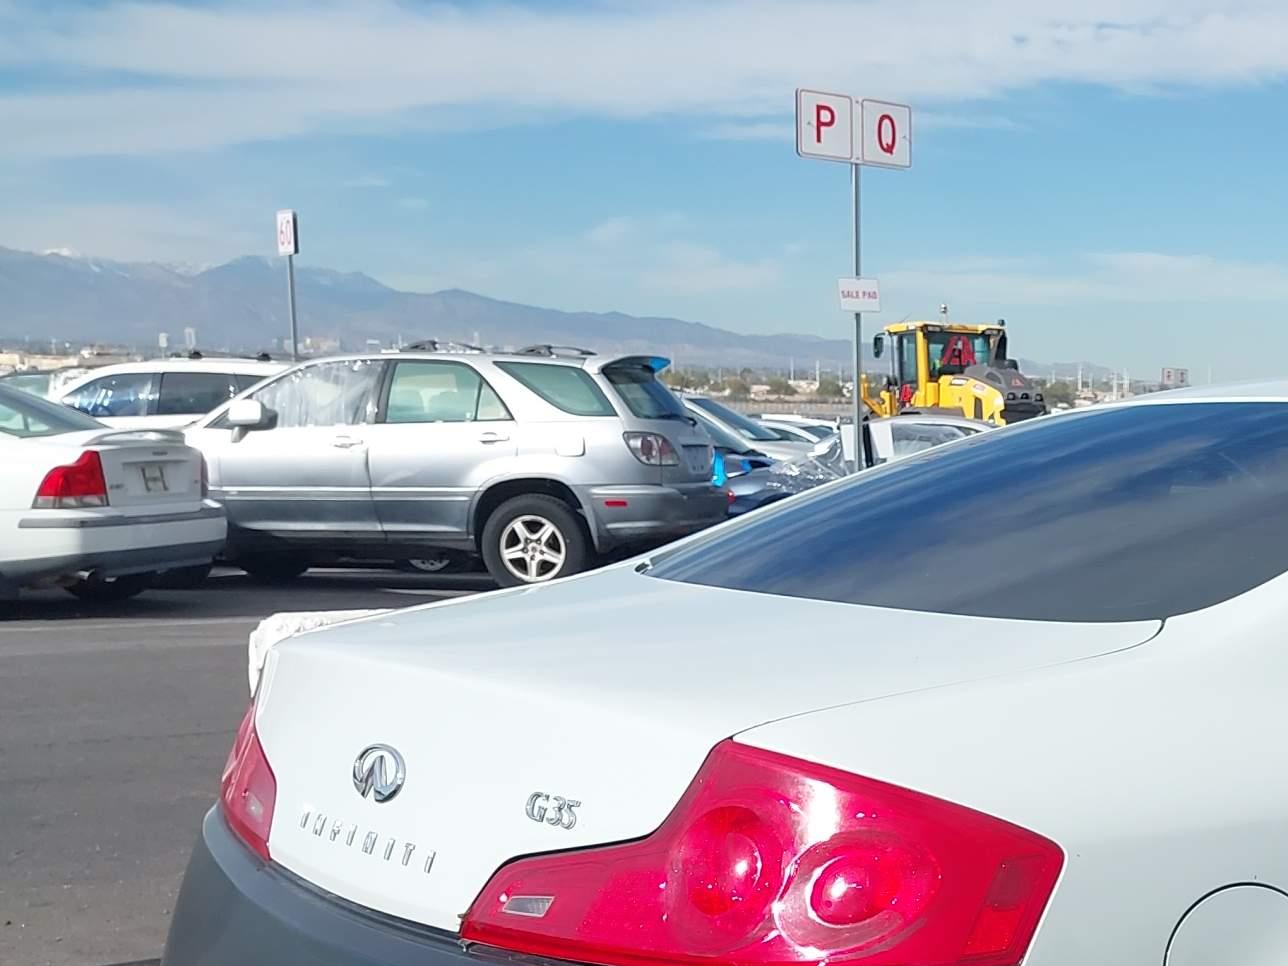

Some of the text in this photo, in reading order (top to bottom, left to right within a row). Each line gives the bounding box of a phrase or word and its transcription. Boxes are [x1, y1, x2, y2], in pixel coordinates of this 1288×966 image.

[816, 104, 835, 143] P
[877, 114, 897, 155] Q
[279, 216, 292, 246] 60
[841, 290, 878, 300] SALE PAD
[525, 791, 582, 830] G35
[300, 811, 436, 874] INFINITI
